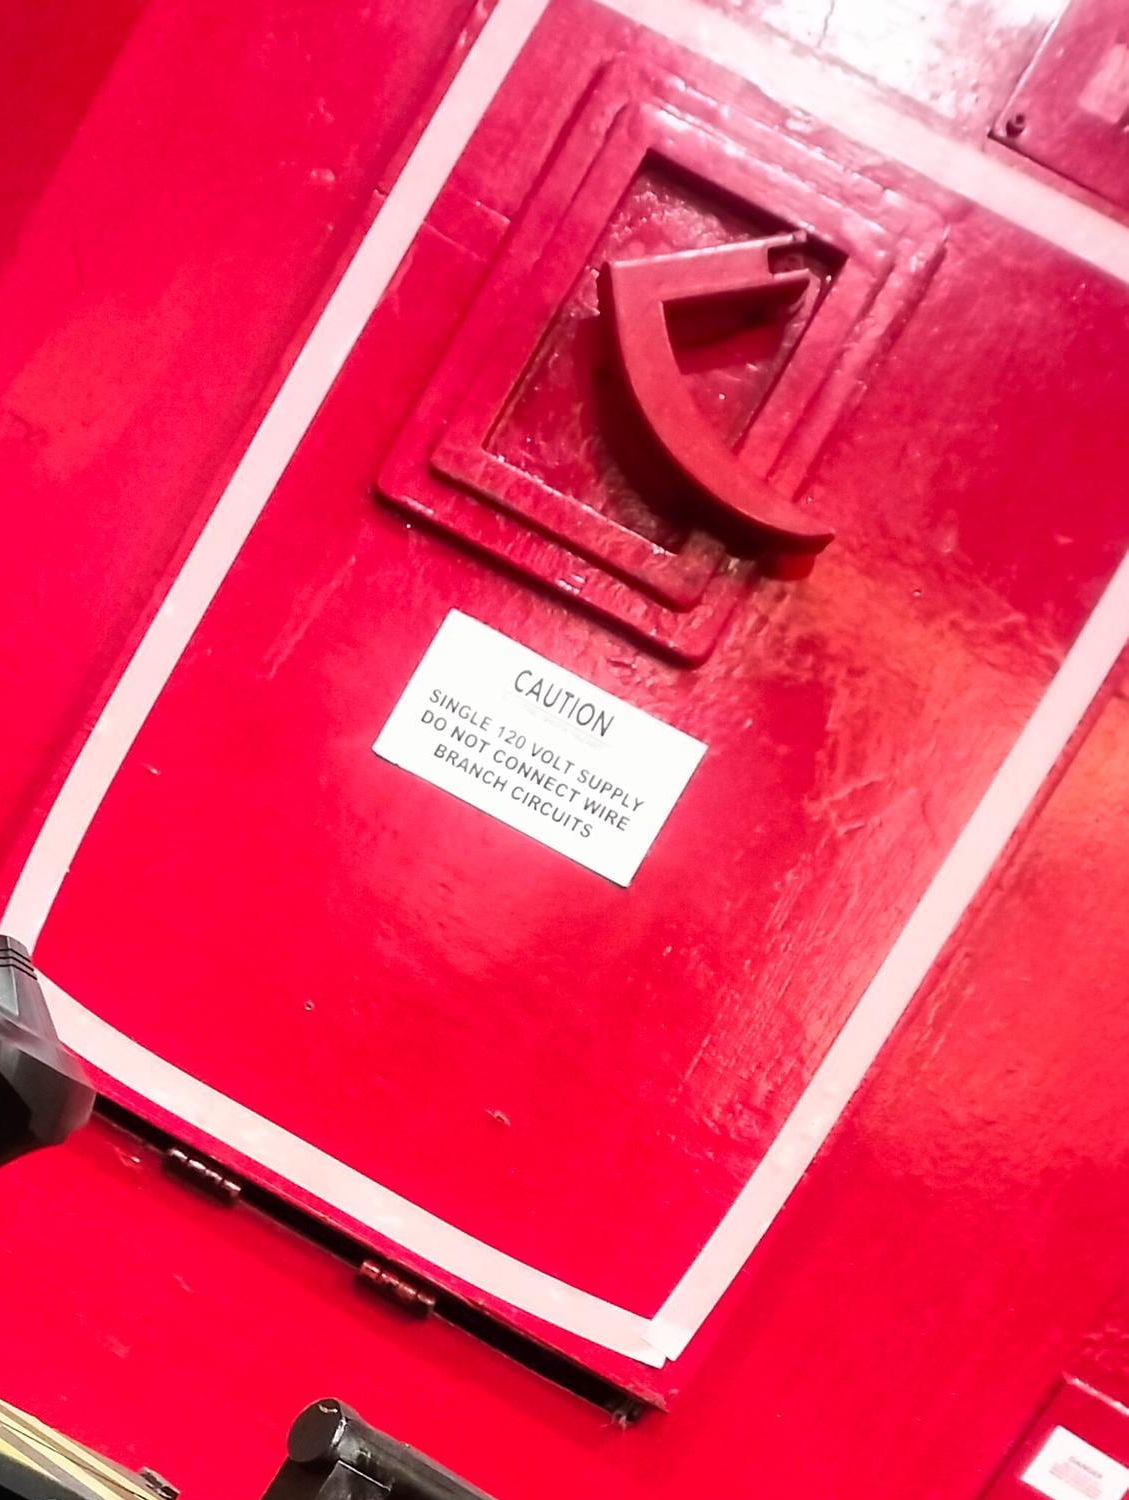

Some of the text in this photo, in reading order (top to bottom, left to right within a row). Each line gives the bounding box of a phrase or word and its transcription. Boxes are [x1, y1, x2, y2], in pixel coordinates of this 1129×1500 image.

[429, 689, 492, 732] SINGLE
[498, 726, 527, 750] 120
[531, 743, 576, 775] VOLT
[576, 769, 645, 812] SUPPLY
[515, 670, 614, 736] CAUTION
[420, 709, 630, 832] DO NOT CONNECT WIRE
[433, 743, 593, 838] BRANCH CIRCUITS
